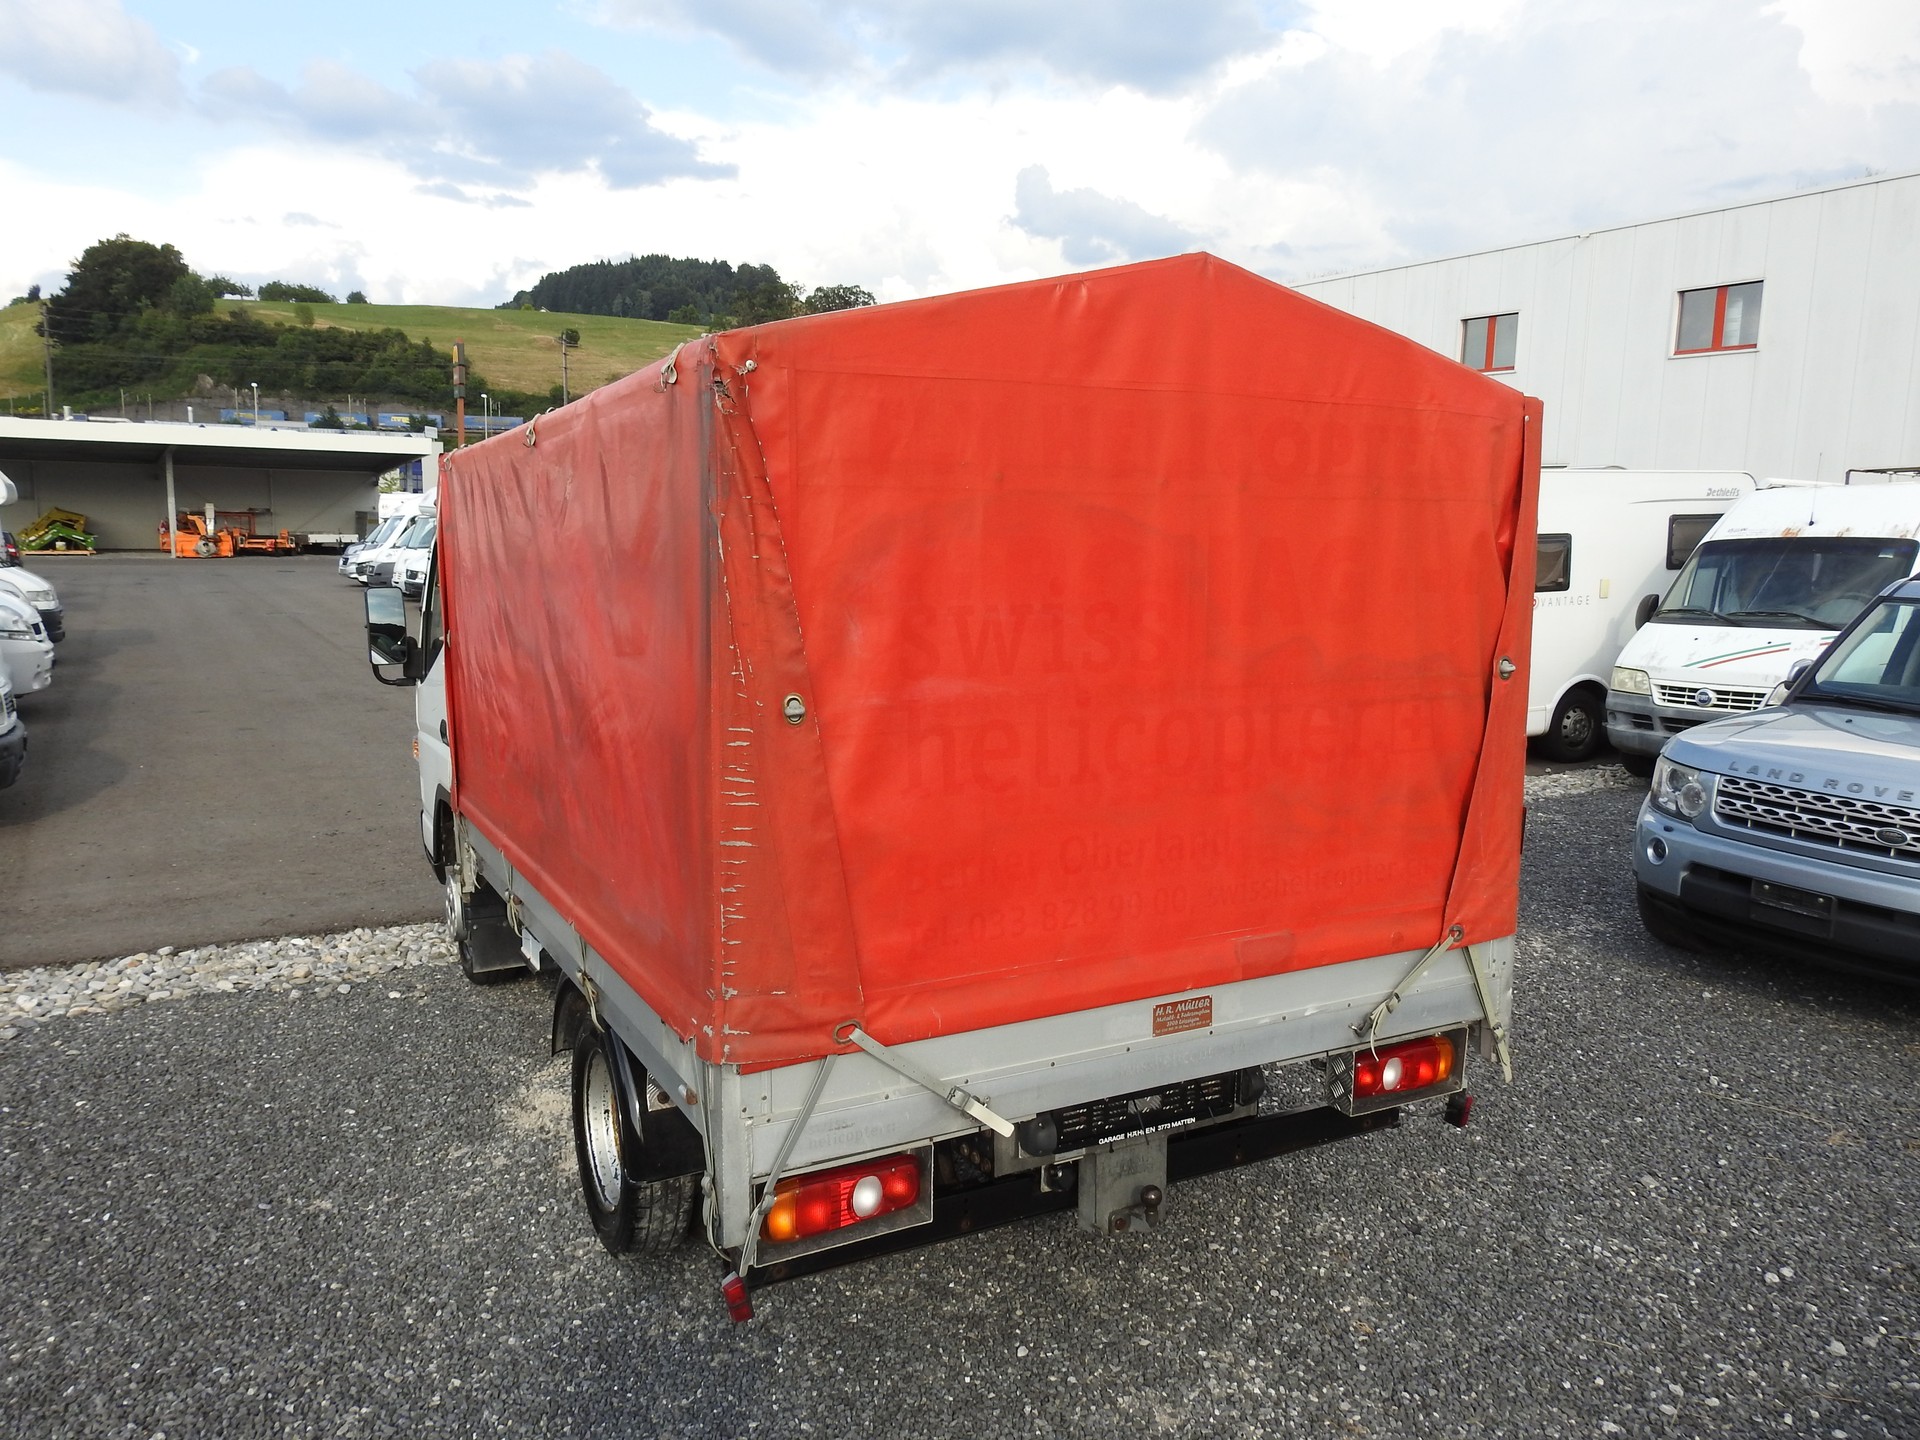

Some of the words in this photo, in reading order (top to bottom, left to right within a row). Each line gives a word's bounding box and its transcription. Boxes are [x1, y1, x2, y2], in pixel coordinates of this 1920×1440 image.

[1728, 761, 1805, 783] LAND
[1098, 1133, 1126, 1145] GARAGE
[1157, 1123, 1171, 1132] 3773
[1171, 1117, 1196, 1128] MATTEN
